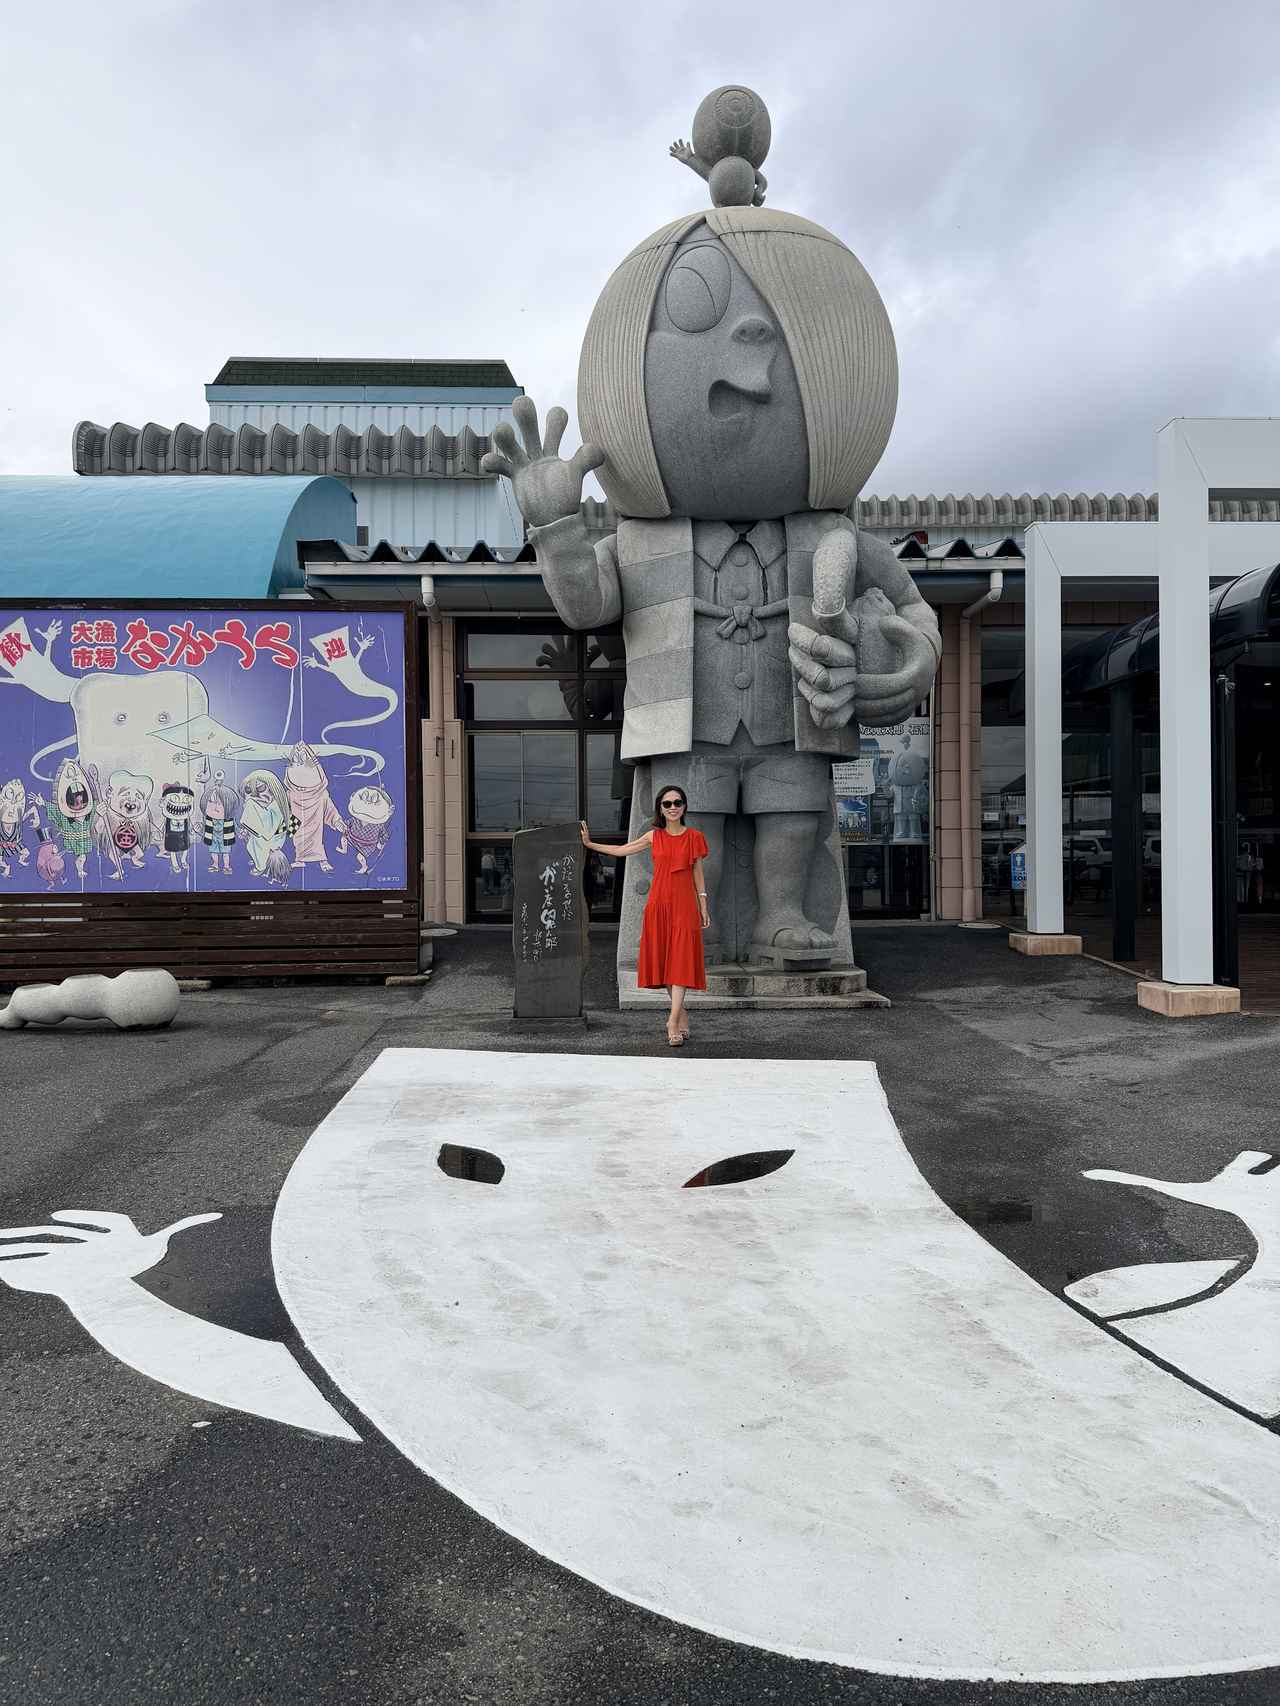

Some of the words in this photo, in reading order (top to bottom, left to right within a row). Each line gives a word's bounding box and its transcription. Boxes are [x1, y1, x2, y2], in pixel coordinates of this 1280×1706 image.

[71, 620, 117, 644] 大漁
[121, 618, 300, 672] なかうら
[322, 637, 347, 661] 迎
[71, 647, 118, 669] 市場
